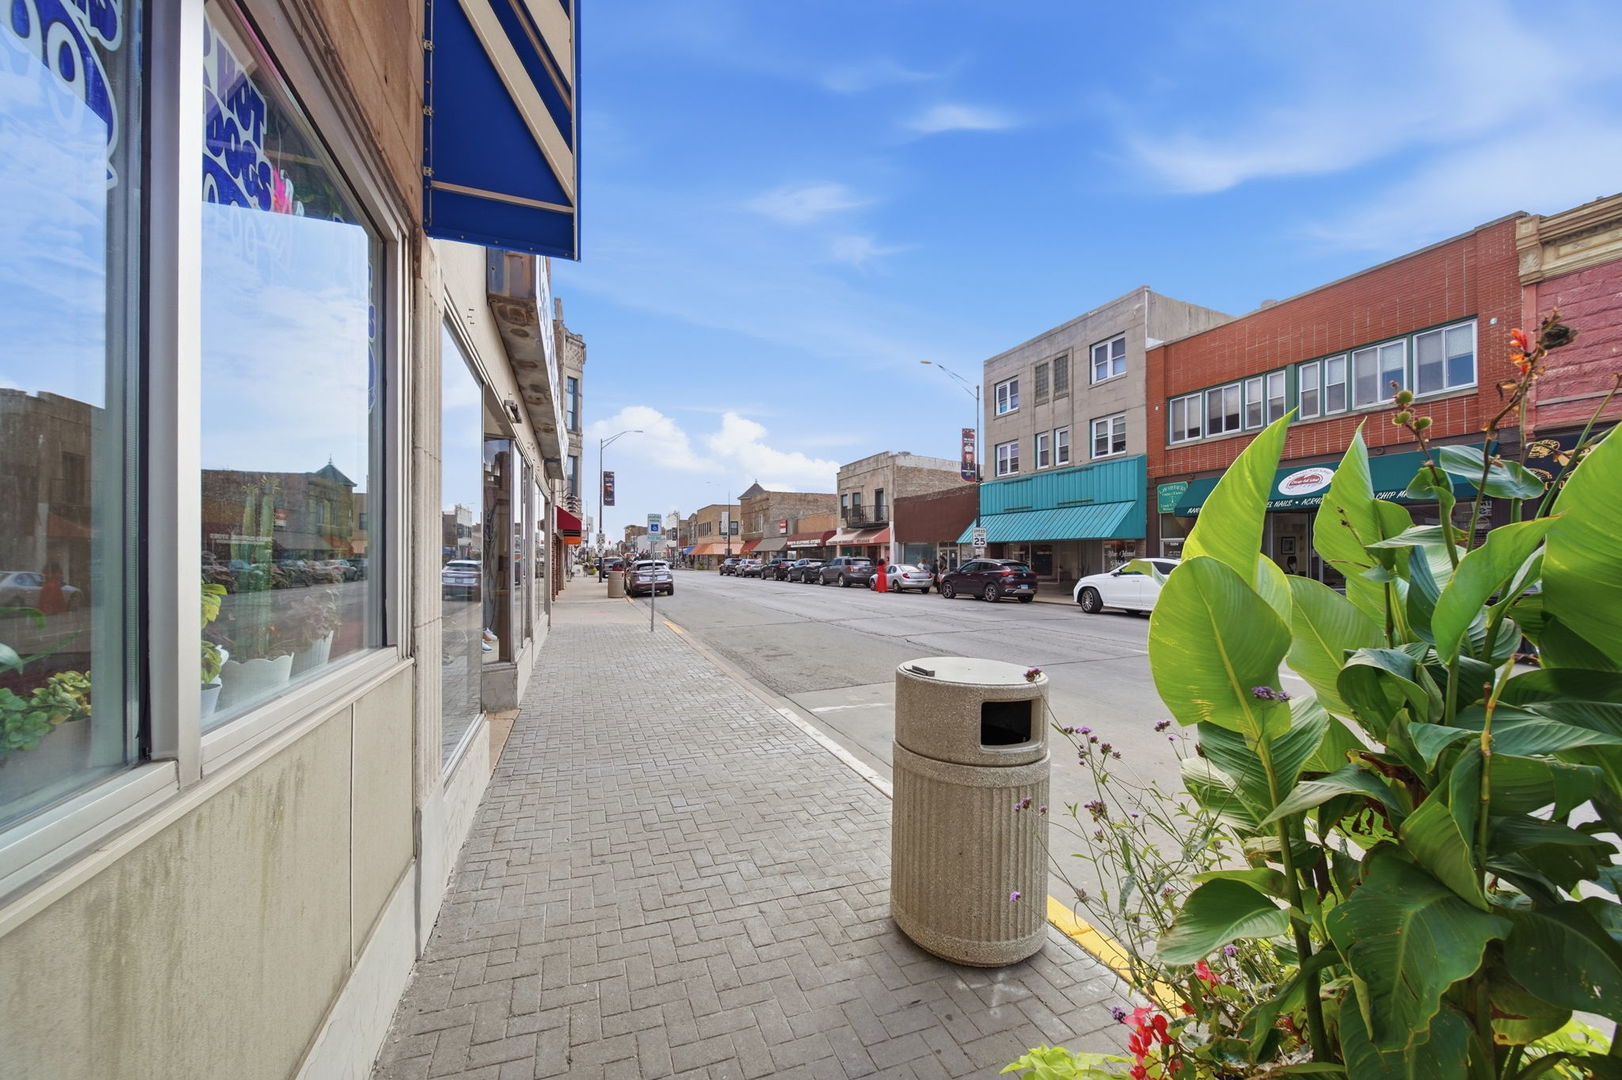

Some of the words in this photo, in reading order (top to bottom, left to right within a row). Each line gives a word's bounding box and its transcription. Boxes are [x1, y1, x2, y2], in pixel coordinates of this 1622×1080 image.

[216, 36, 267, 149] HOT
[205, 85, 274, 212] DOGS
[1375, 491, 1396, 500] CHIP
[1274, 499, 1292, 508] NAILS
[974, 537, 985, 546] 25
